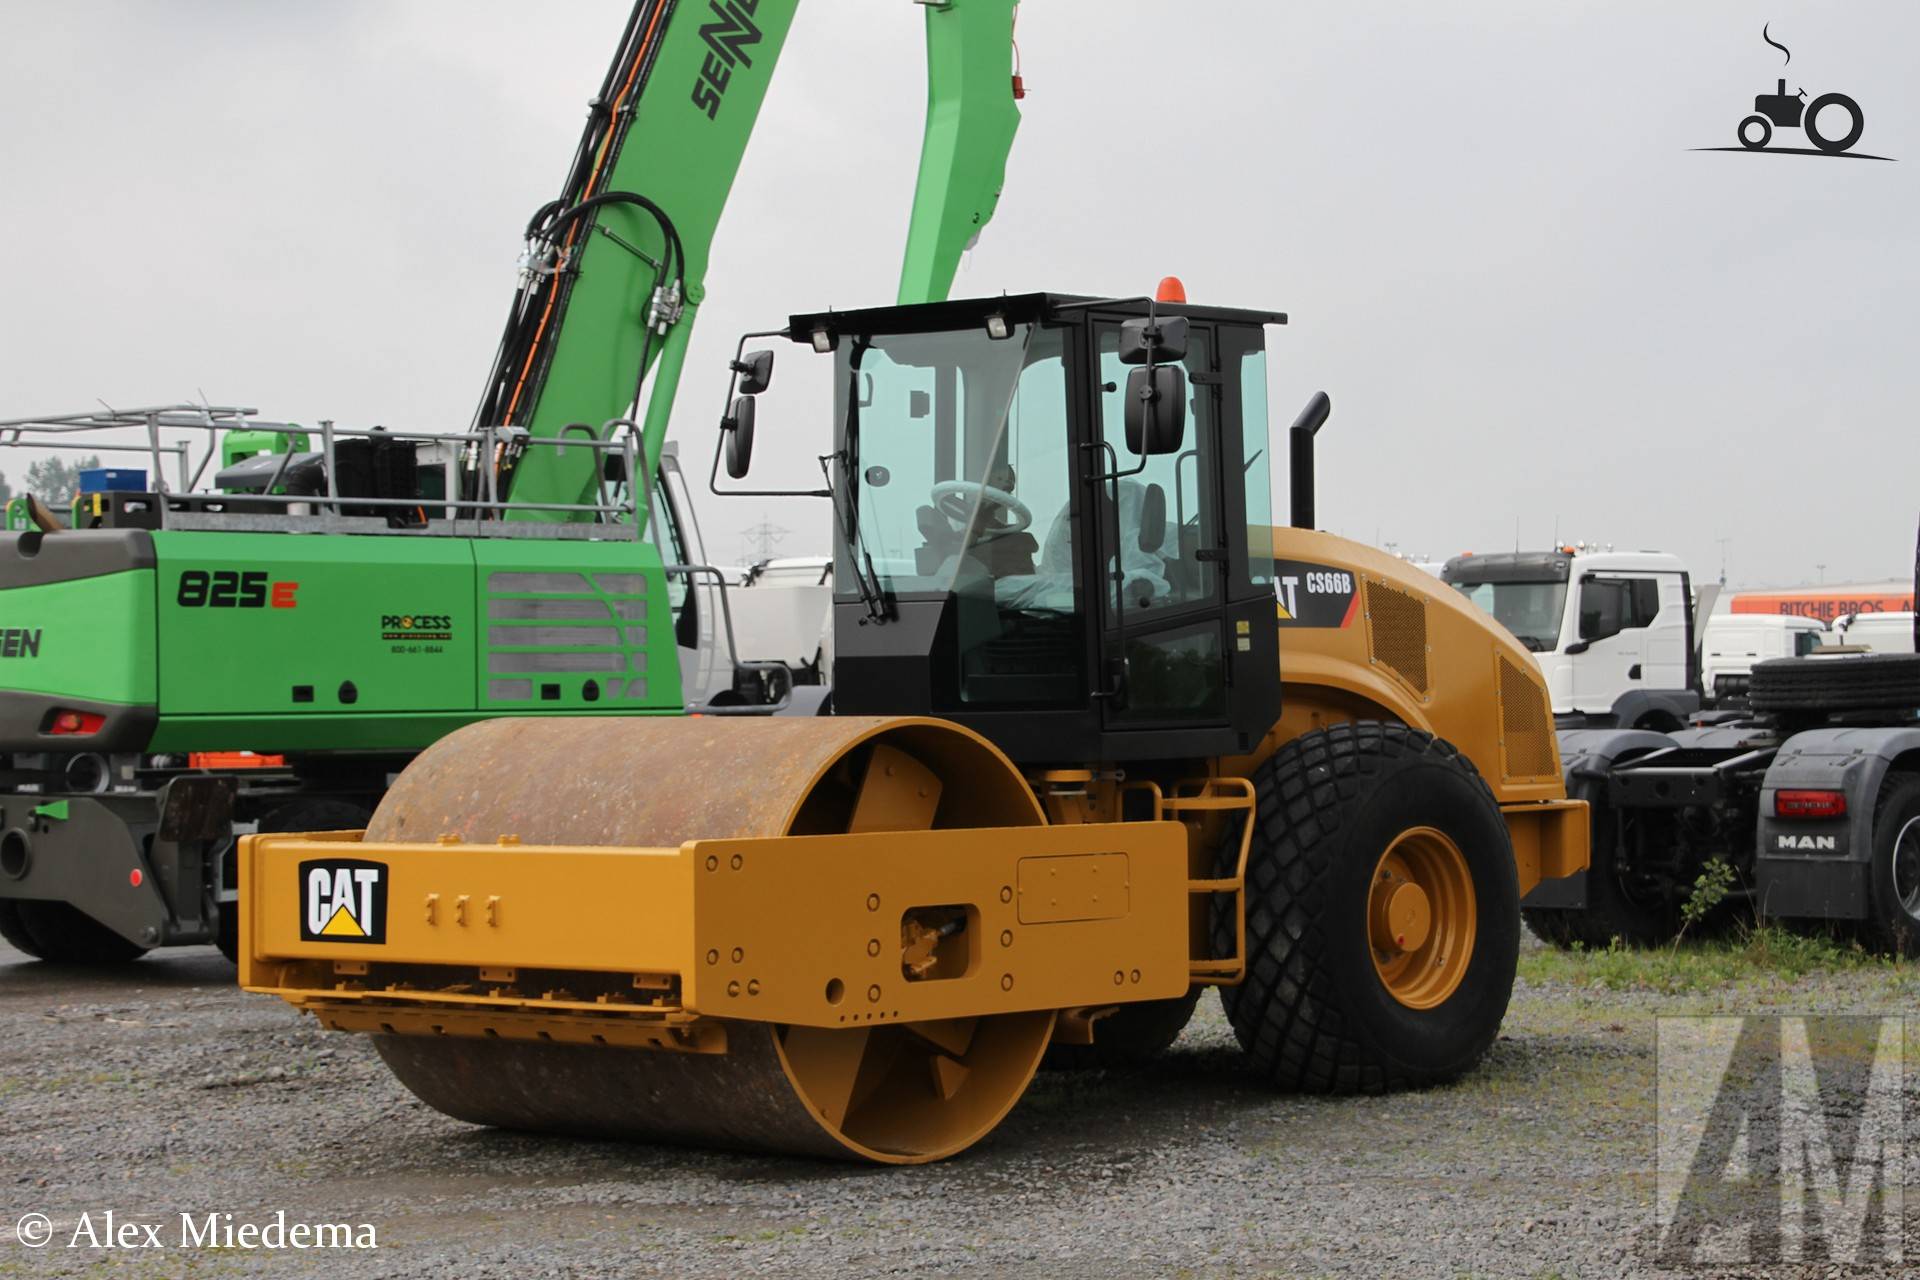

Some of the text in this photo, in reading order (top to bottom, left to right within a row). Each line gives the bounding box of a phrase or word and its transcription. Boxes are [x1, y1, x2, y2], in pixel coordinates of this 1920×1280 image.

[691, 0, 762, 121] SENN
[177, 570, 299, 608] 825 E
[1306, 571, 1351, 594] CS66B
[381, 614, 452, 630] PROCESS
[1780, 601, 1834, 618] RITCHIE
[0, 629, 42, 658] EN
[1778, 835, 1835, 849] MAN
[307, 867, 379, 937] CAT
